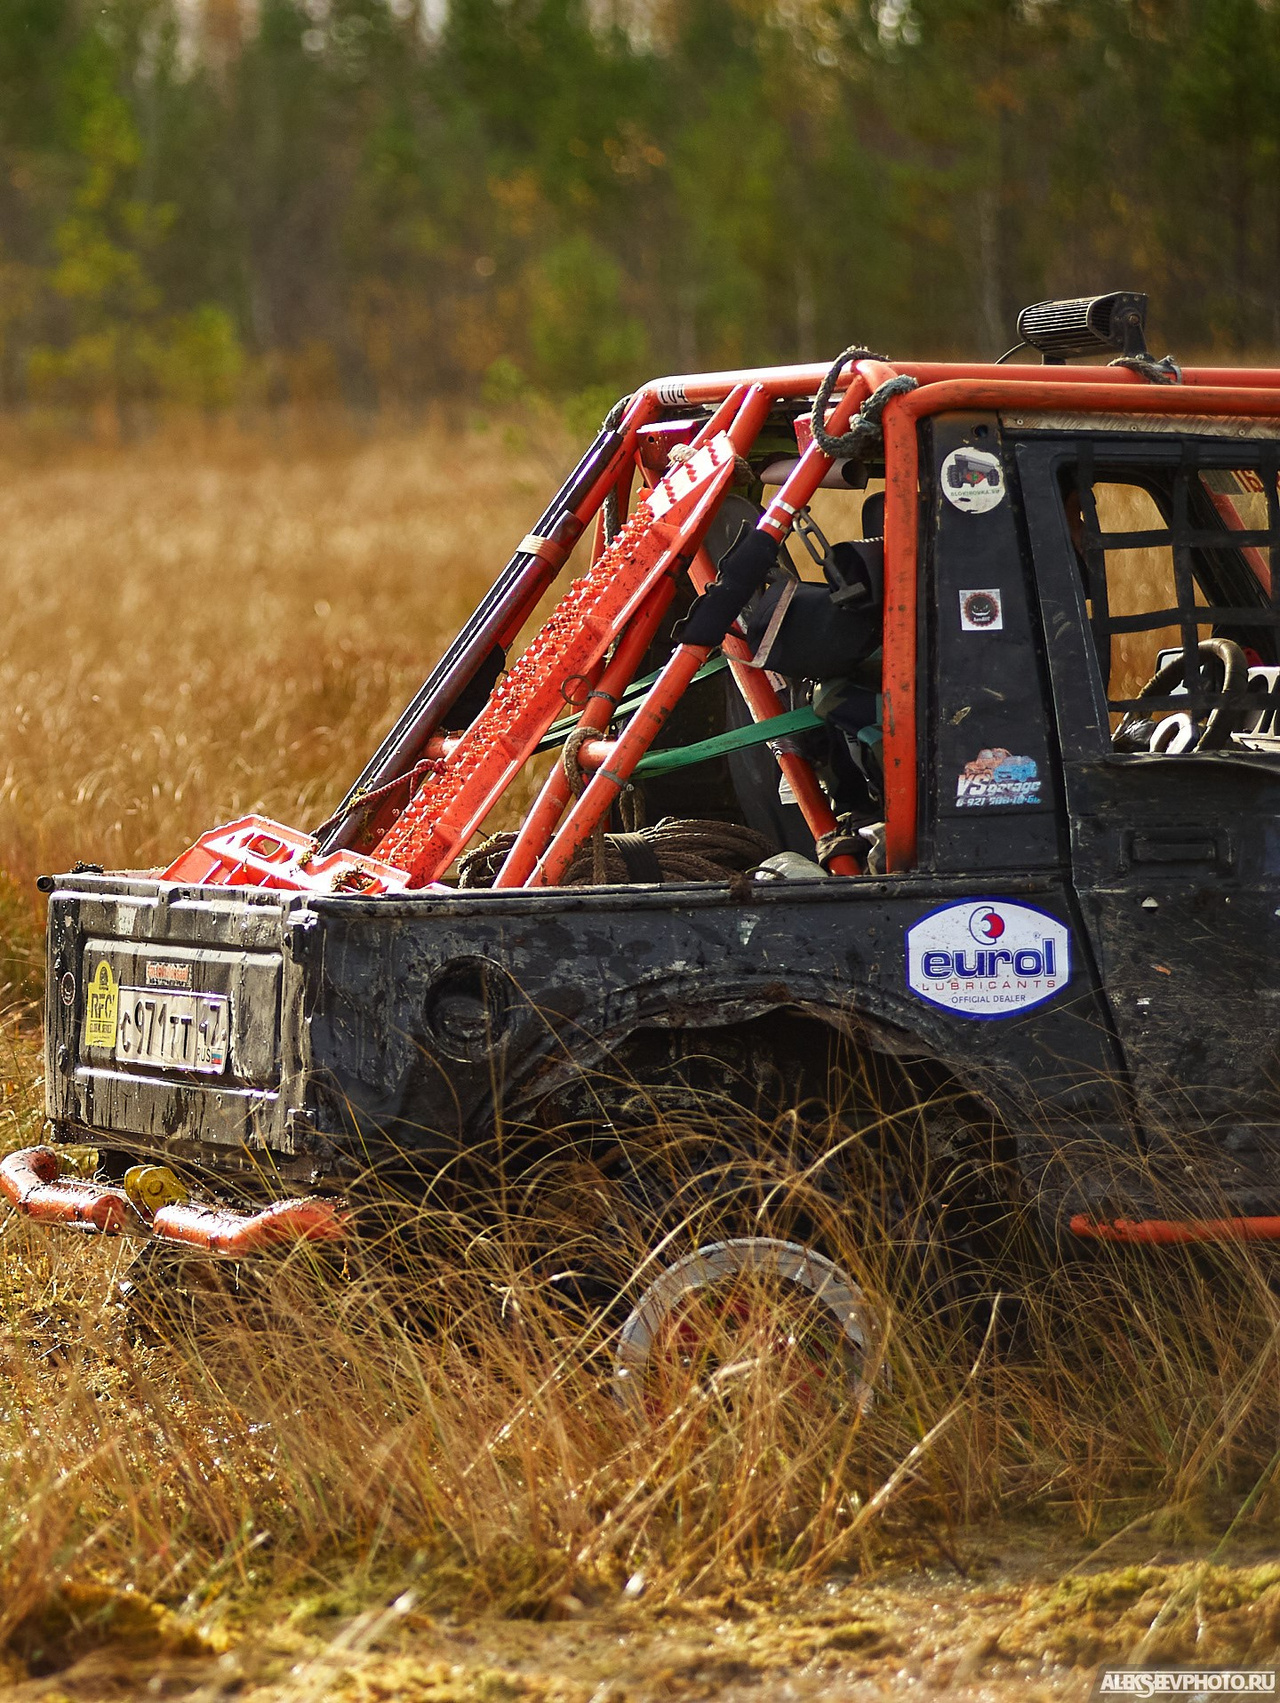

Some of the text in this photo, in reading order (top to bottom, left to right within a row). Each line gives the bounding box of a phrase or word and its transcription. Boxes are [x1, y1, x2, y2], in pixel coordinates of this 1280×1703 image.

[921, 938, 1056, 980] eurol
[922, 979, 1056, 991] LUBRICANTS
[951, 994, 1026, 1004] OFFICIAL DEALER
